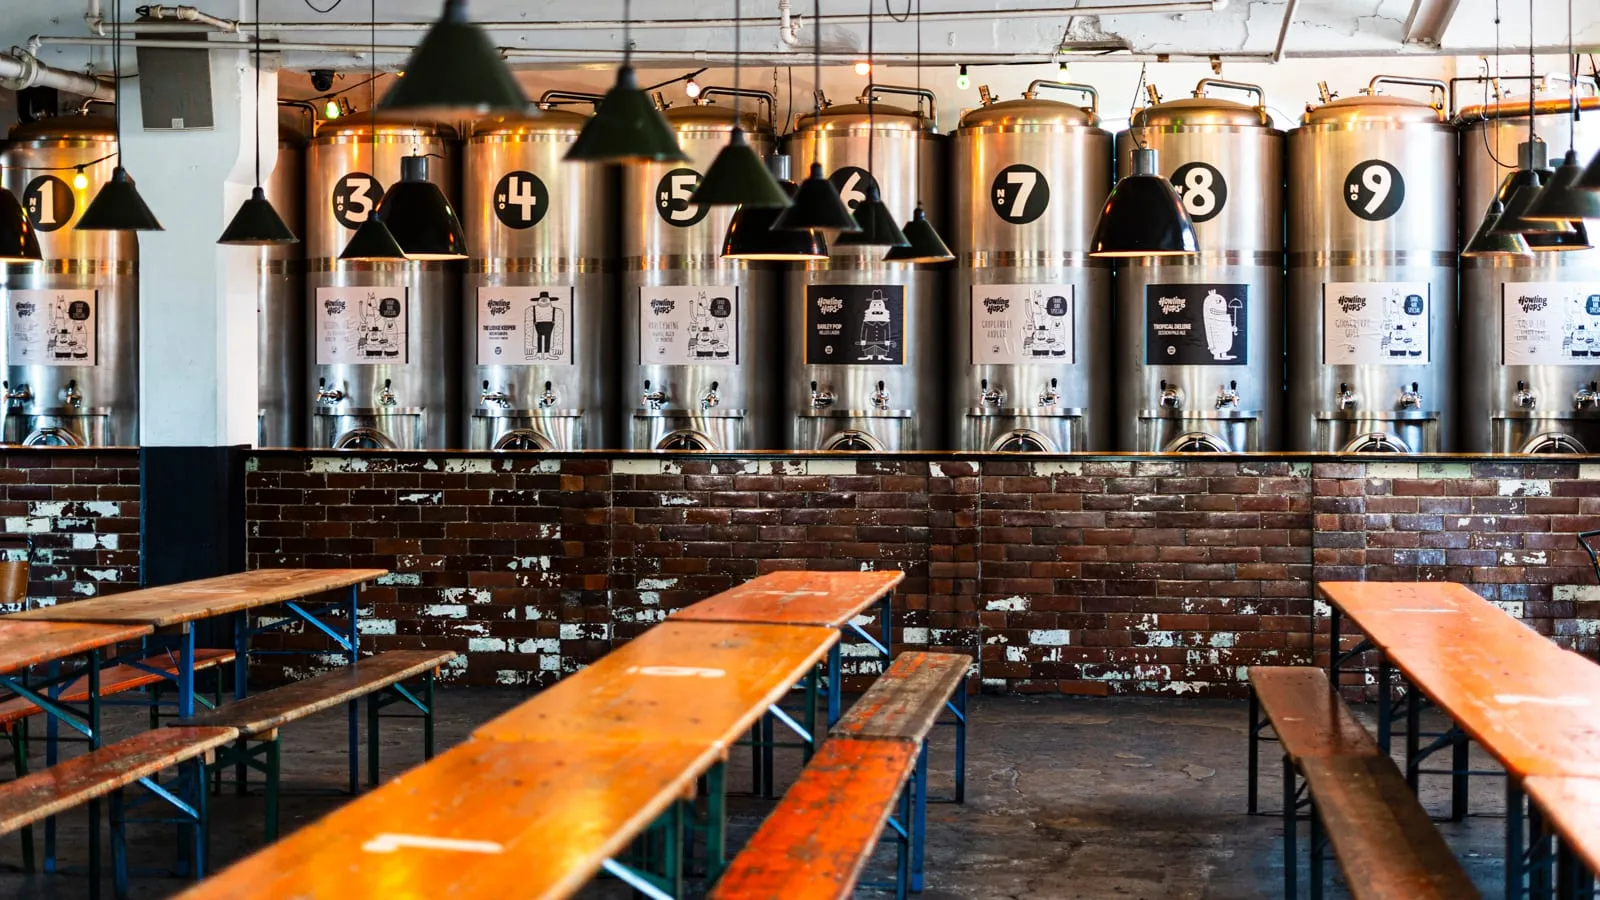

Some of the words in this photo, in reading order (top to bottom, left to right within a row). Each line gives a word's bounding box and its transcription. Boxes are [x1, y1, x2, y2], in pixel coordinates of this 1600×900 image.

[37, 180, 57, 224] 1
[345, 178, 373, 223] 3
[508, 176, 537, 221] 4
[670, 175, 699, 221] 5
[840, 171, 867, 216] 6
[1007, 172, 1037, 217] 7
[1182, 167, 1216, 216] 8
[1362, 165, 1392, 214] 9
[1338, 295, 1367, 307] Howling
[1518, 295, 1548, 307] Howling
